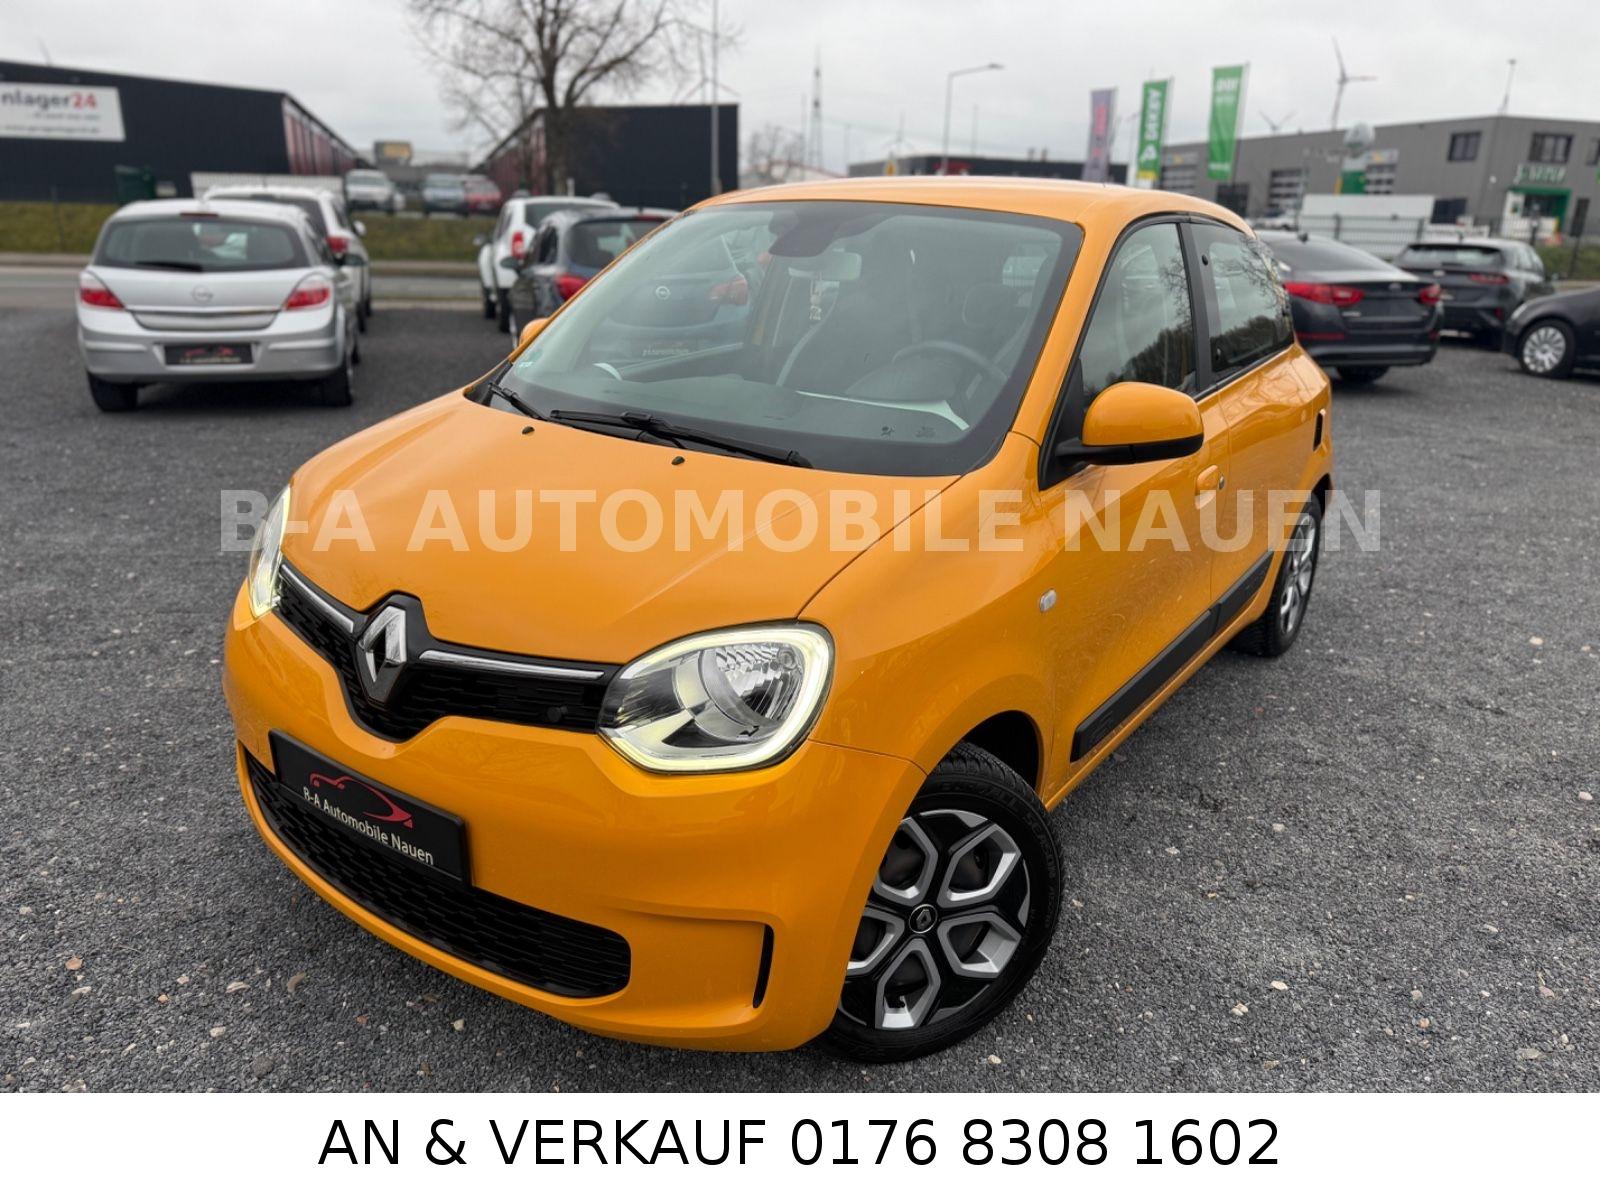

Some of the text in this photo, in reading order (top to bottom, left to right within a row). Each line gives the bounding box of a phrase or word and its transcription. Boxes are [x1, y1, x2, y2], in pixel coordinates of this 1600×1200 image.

[303, 786, 434, 866] B-A Automobile Nauen
